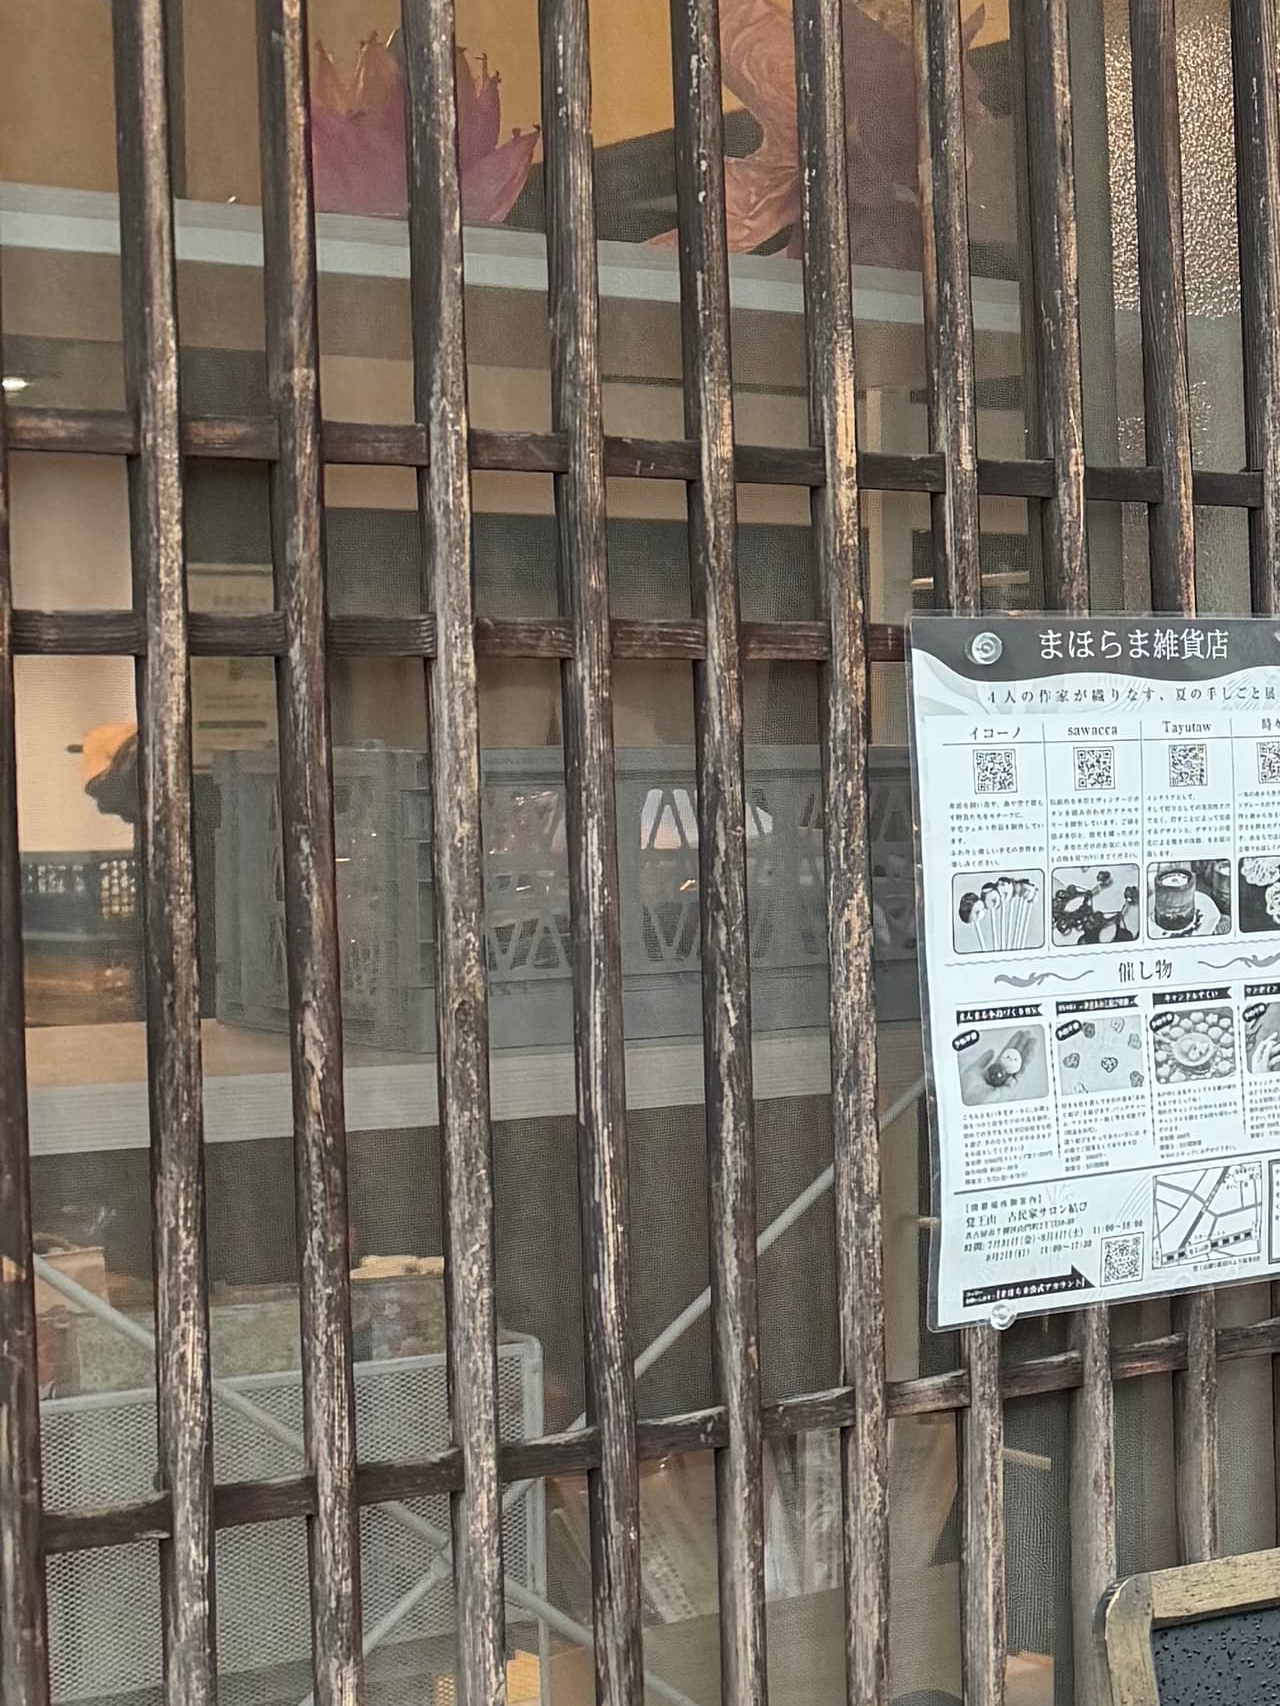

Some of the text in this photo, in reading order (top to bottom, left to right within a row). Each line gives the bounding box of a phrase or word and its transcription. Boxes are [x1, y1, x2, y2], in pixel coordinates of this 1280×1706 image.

[1039, 629, 1230, 660] まほらま雑貨店
[1067, 725, 1119, 737] sawacca
[1162, 720, 1213, 735] Tayutaw
[1118, 959, 1173, 983] 催し物
